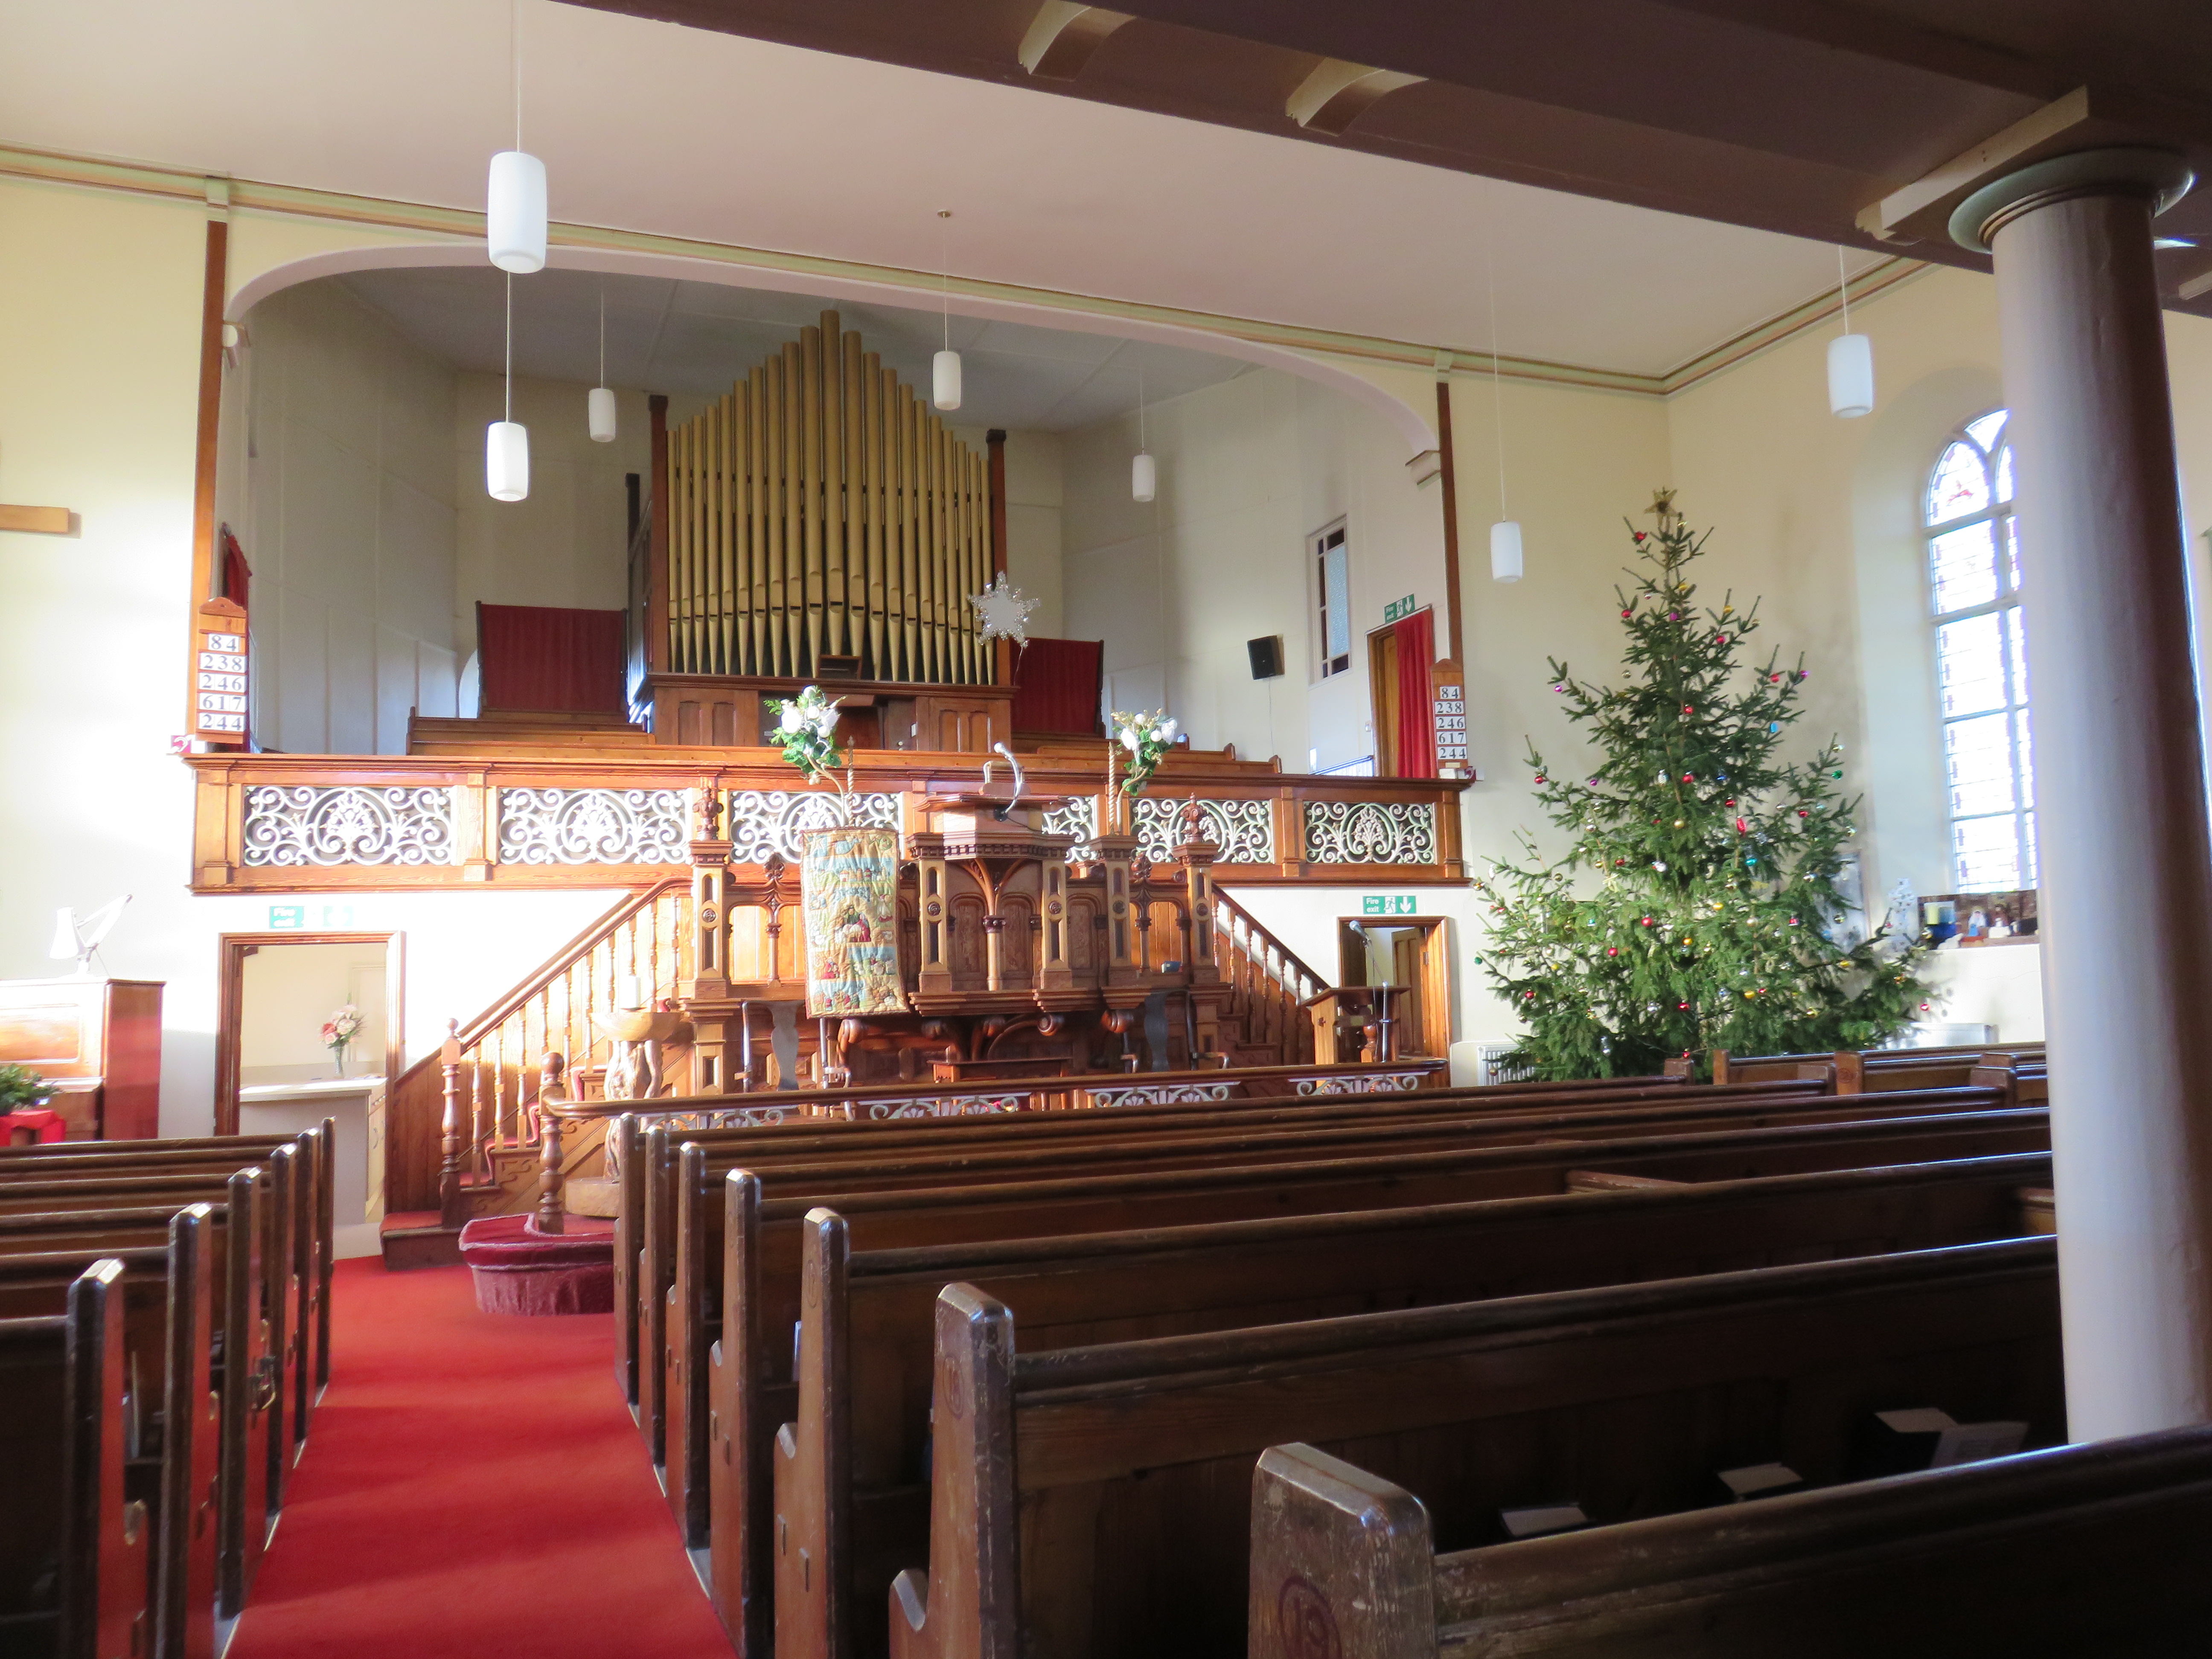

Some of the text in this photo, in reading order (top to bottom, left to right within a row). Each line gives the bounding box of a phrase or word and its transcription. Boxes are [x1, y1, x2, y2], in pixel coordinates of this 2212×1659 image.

[211, 635, 237, 651] 84
[204, 655, 242, 671] 238
[202, 674, 242, 690] 246
[1441, 687, 1458, 699] 84
[203, 695, 242, 710] 617
[1437, 702, 1461, 713] 238
[202, 714, 241, 730] 244
[1438, 717, 1464, 728] 246
[1438, 733, 1464, 743] 617
[1440, 748, 1466, 759] 244
